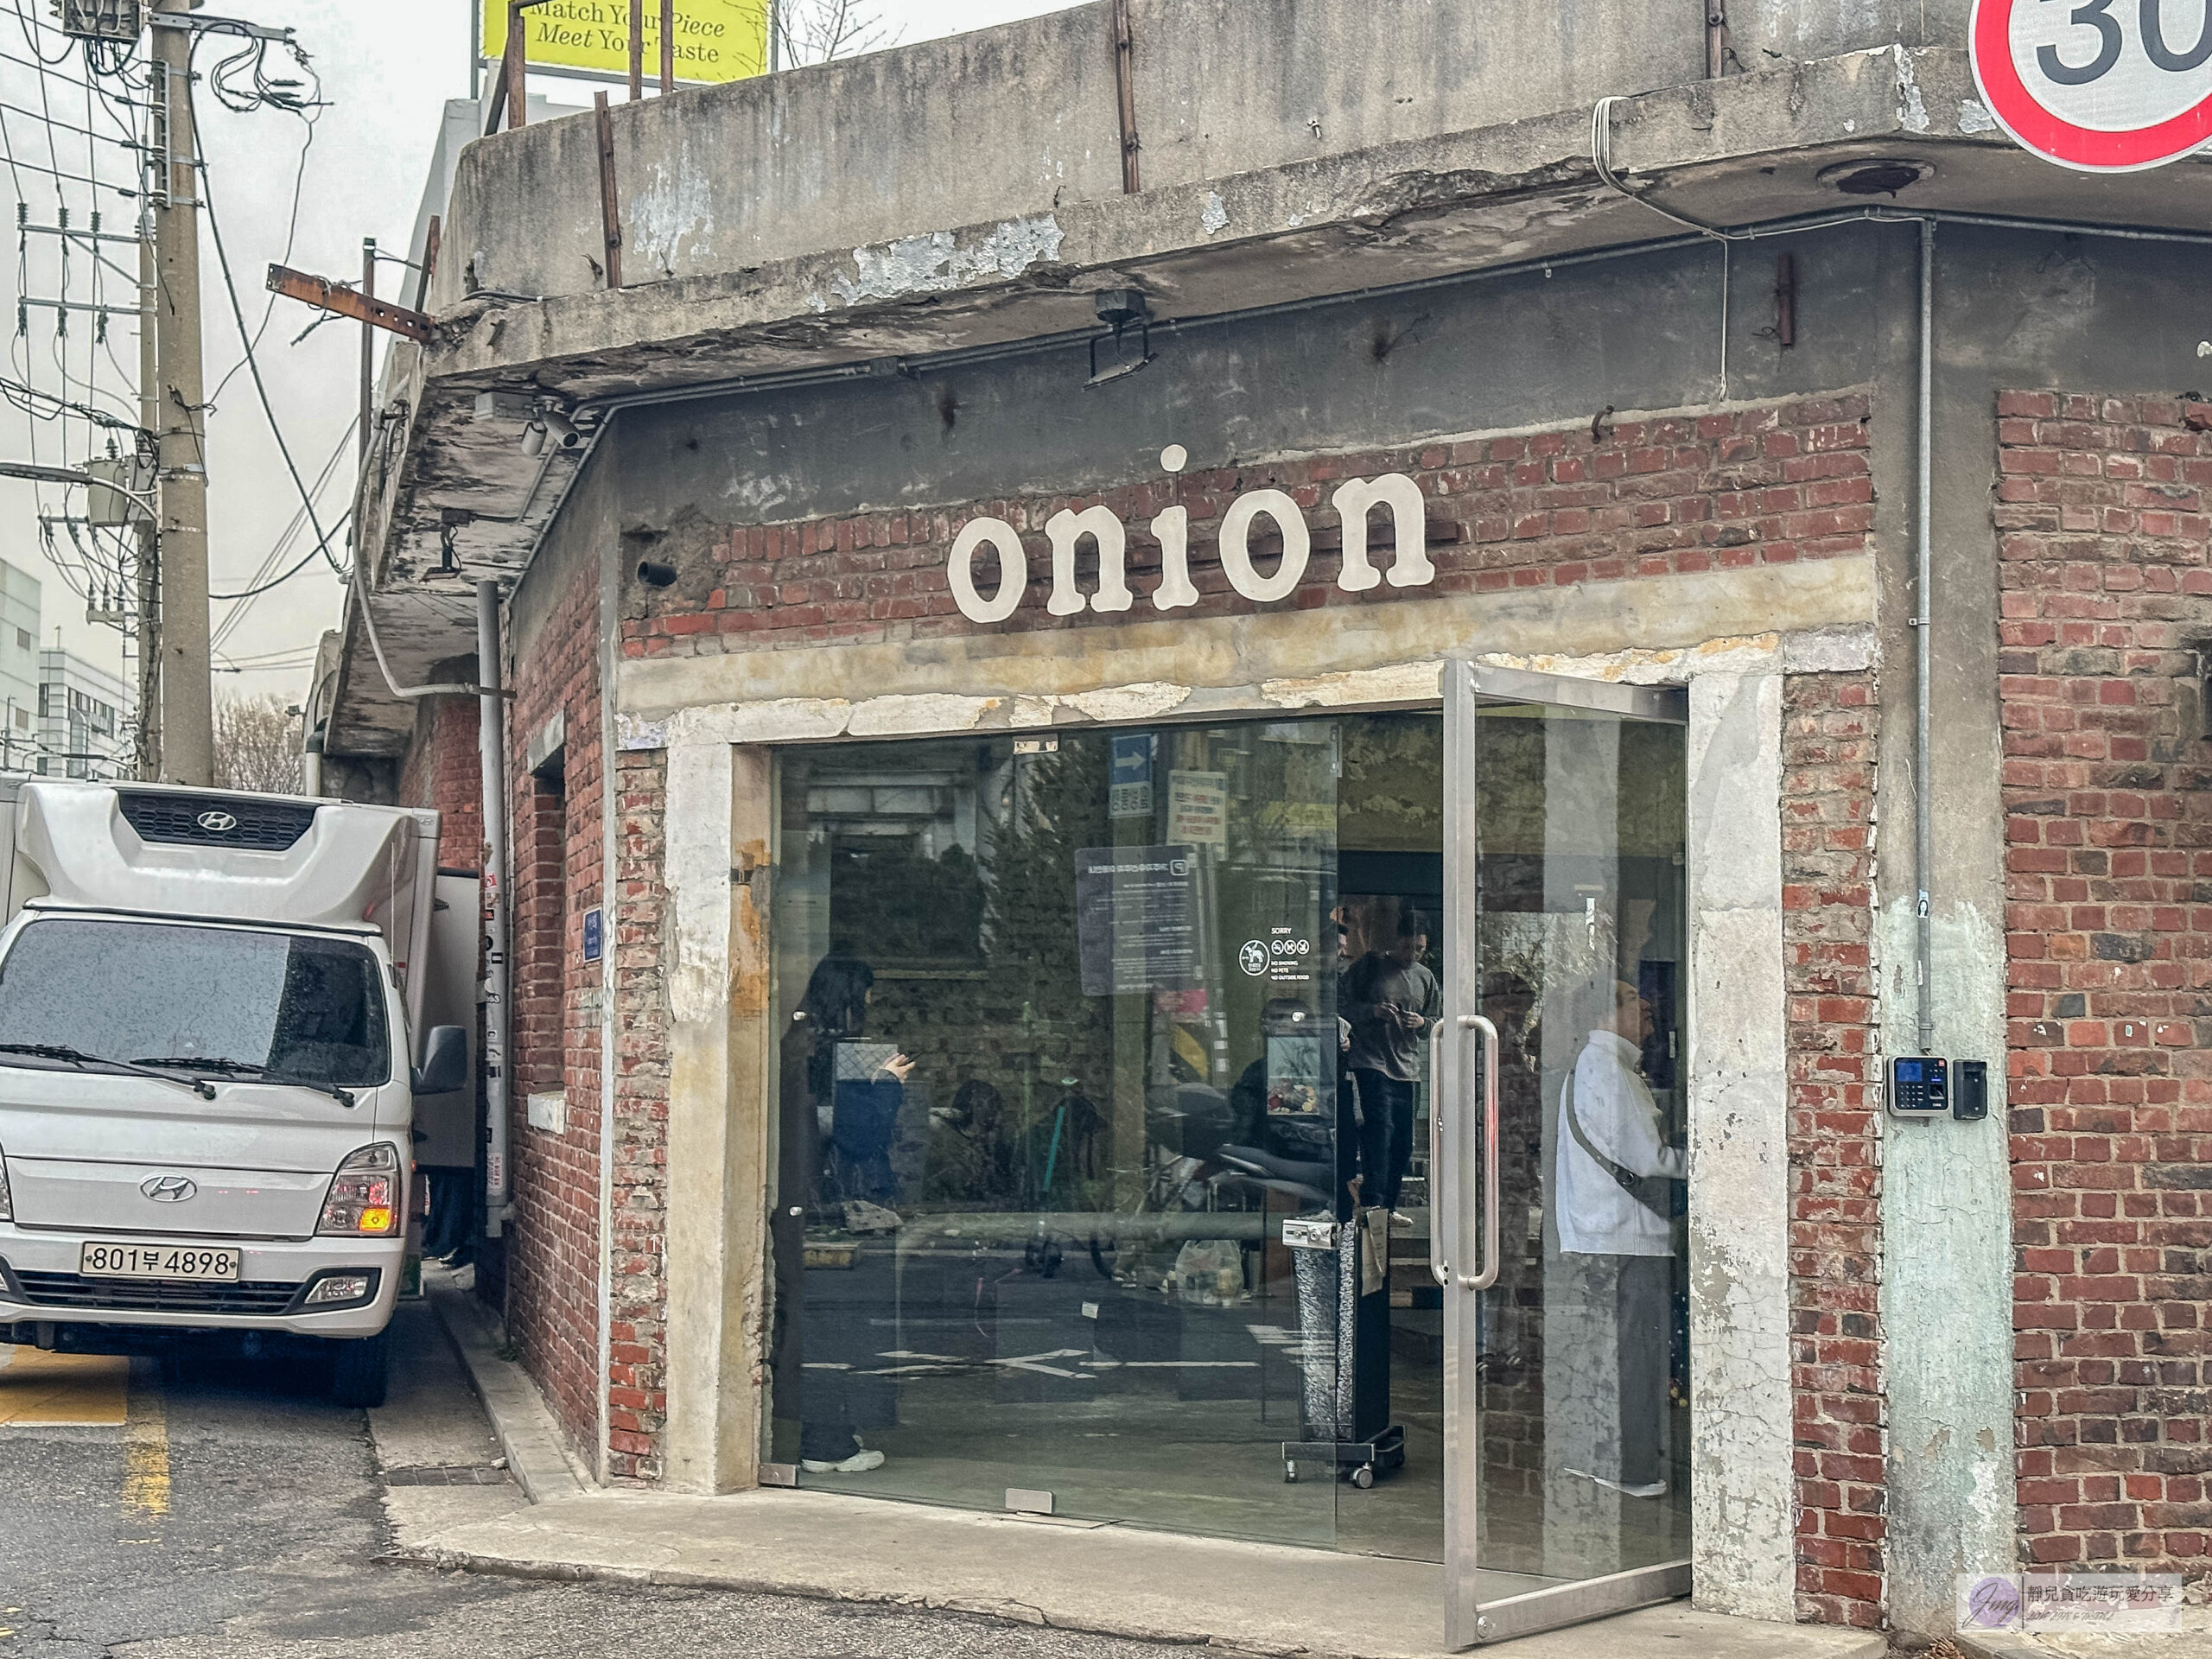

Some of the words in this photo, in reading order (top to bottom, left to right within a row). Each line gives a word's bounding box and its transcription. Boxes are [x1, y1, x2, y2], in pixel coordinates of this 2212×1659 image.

[530, 2, 604, 22] Match
[536, 22, 594, 48] Meet
[598, 29, 651, 54] Yor
[655, 36, 719, 63] aste
[2037, 0, 2212, 85] 30
[947, 444, 1435, 624] onion
